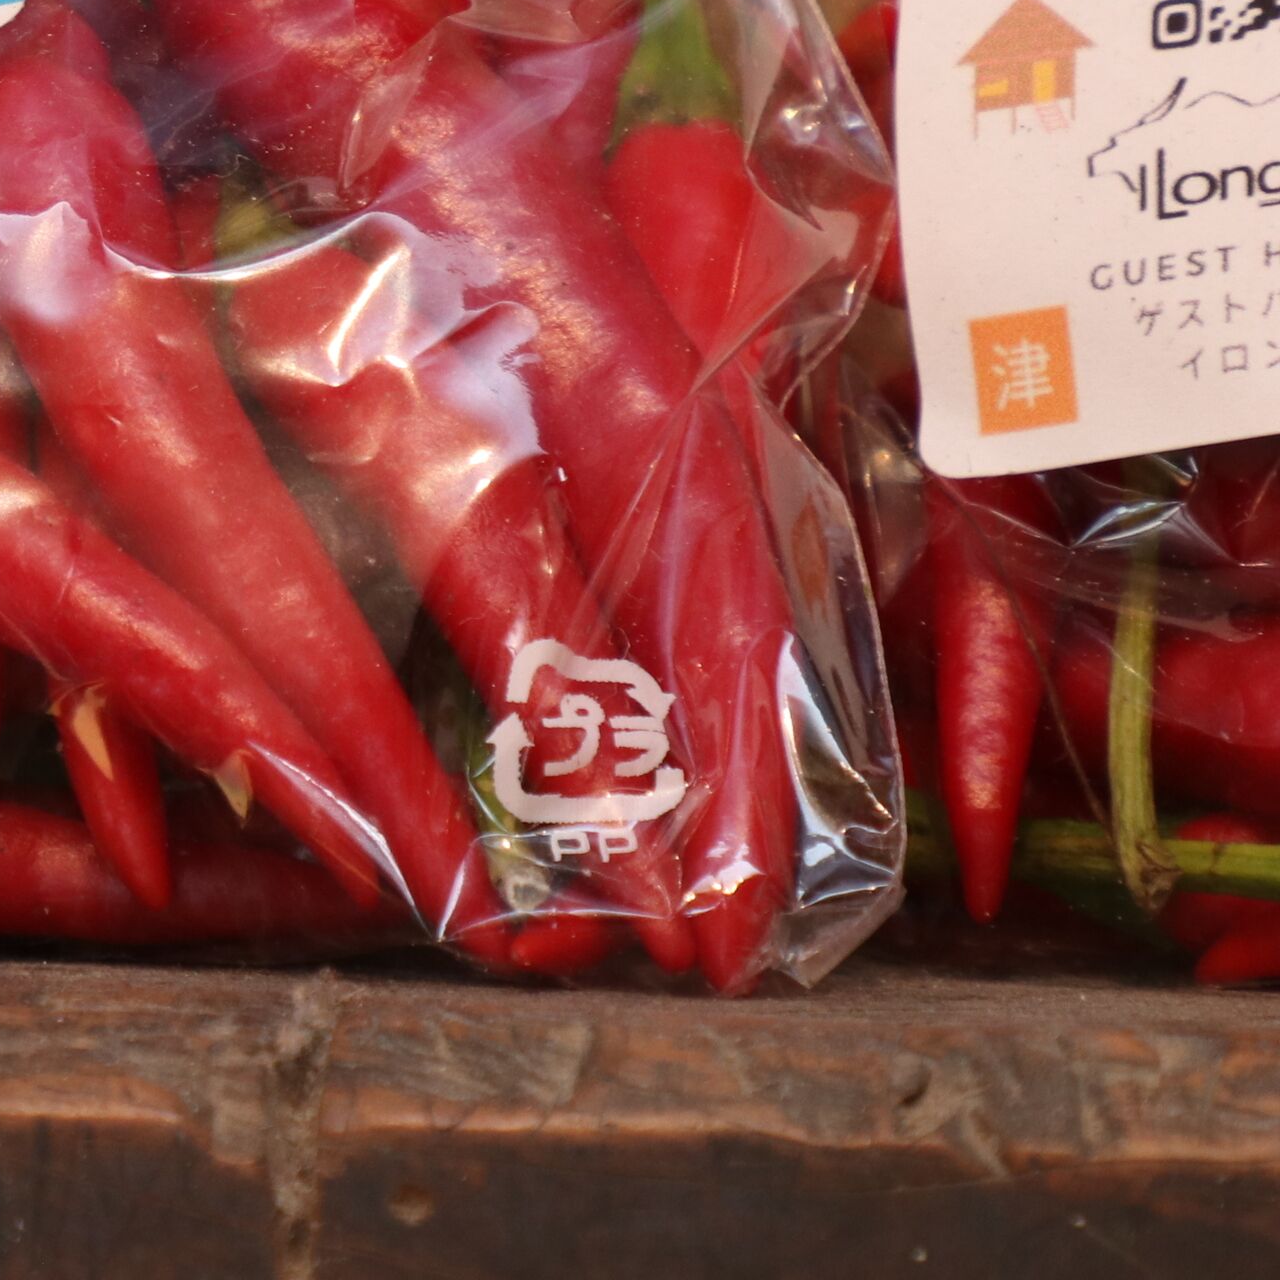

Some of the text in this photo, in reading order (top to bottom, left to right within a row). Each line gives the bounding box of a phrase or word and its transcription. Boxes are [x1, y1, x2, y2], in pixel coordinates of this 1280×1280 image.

[1089, 244, 1239, 292] GUEST
[990, 337, 1054, 410] 津
[549, 829, 639, 863] PP
